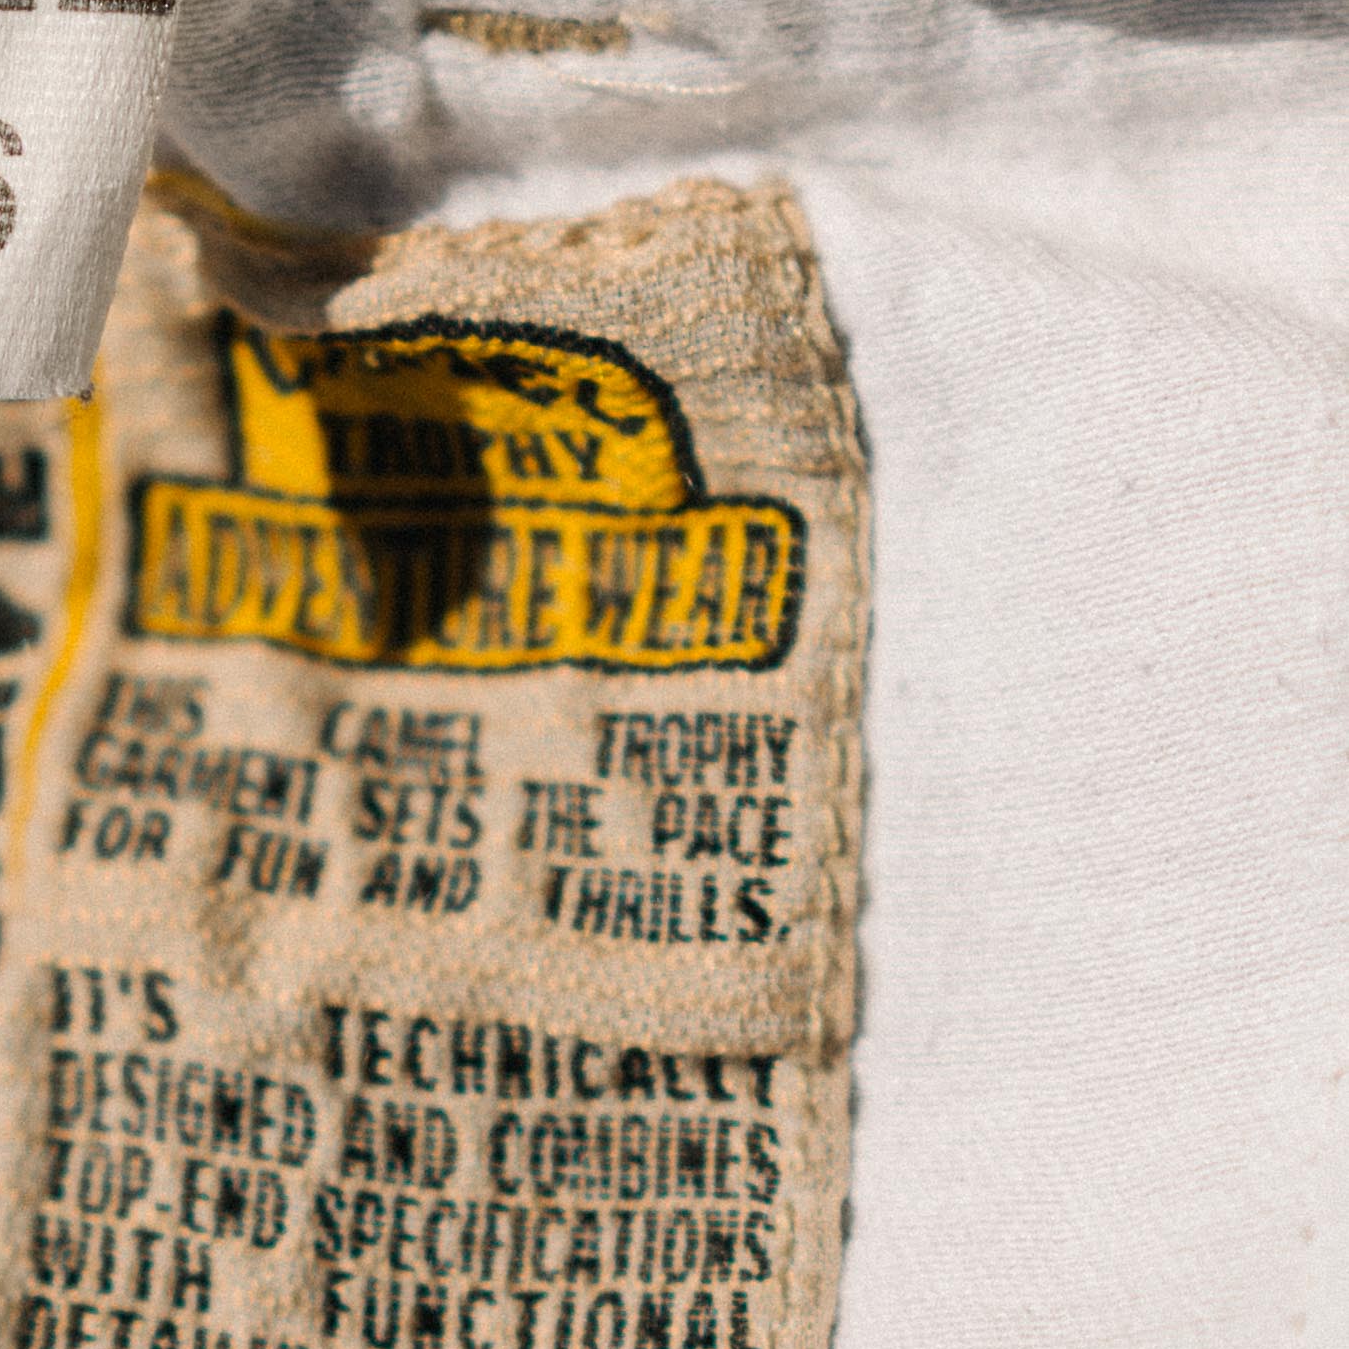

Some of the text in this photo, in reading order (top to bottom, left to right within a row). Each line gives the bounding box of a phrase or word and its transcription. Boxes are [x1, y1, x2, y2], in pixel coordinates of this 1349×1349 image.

[325, 414, 603, 483] TROPHY
[584, 520, 784, 650] WEAR
[97, 671, 798, 790] THIS CAMEL TROPHY
[75, 731, 792, 868] GARMENT SETS THE PACE
[60, 798, 791, 944] FOR FUN AND THRILLS.
[51, 966, 782, 1109] IT'S TECHNICALLY
[49, 1049, 781, 1205] DESIGNED AND COMBINES
[31, 1213, 212, 1314] WITH
[48, 1136, 776, 1285] TOP-END SPECIFICATIONS
